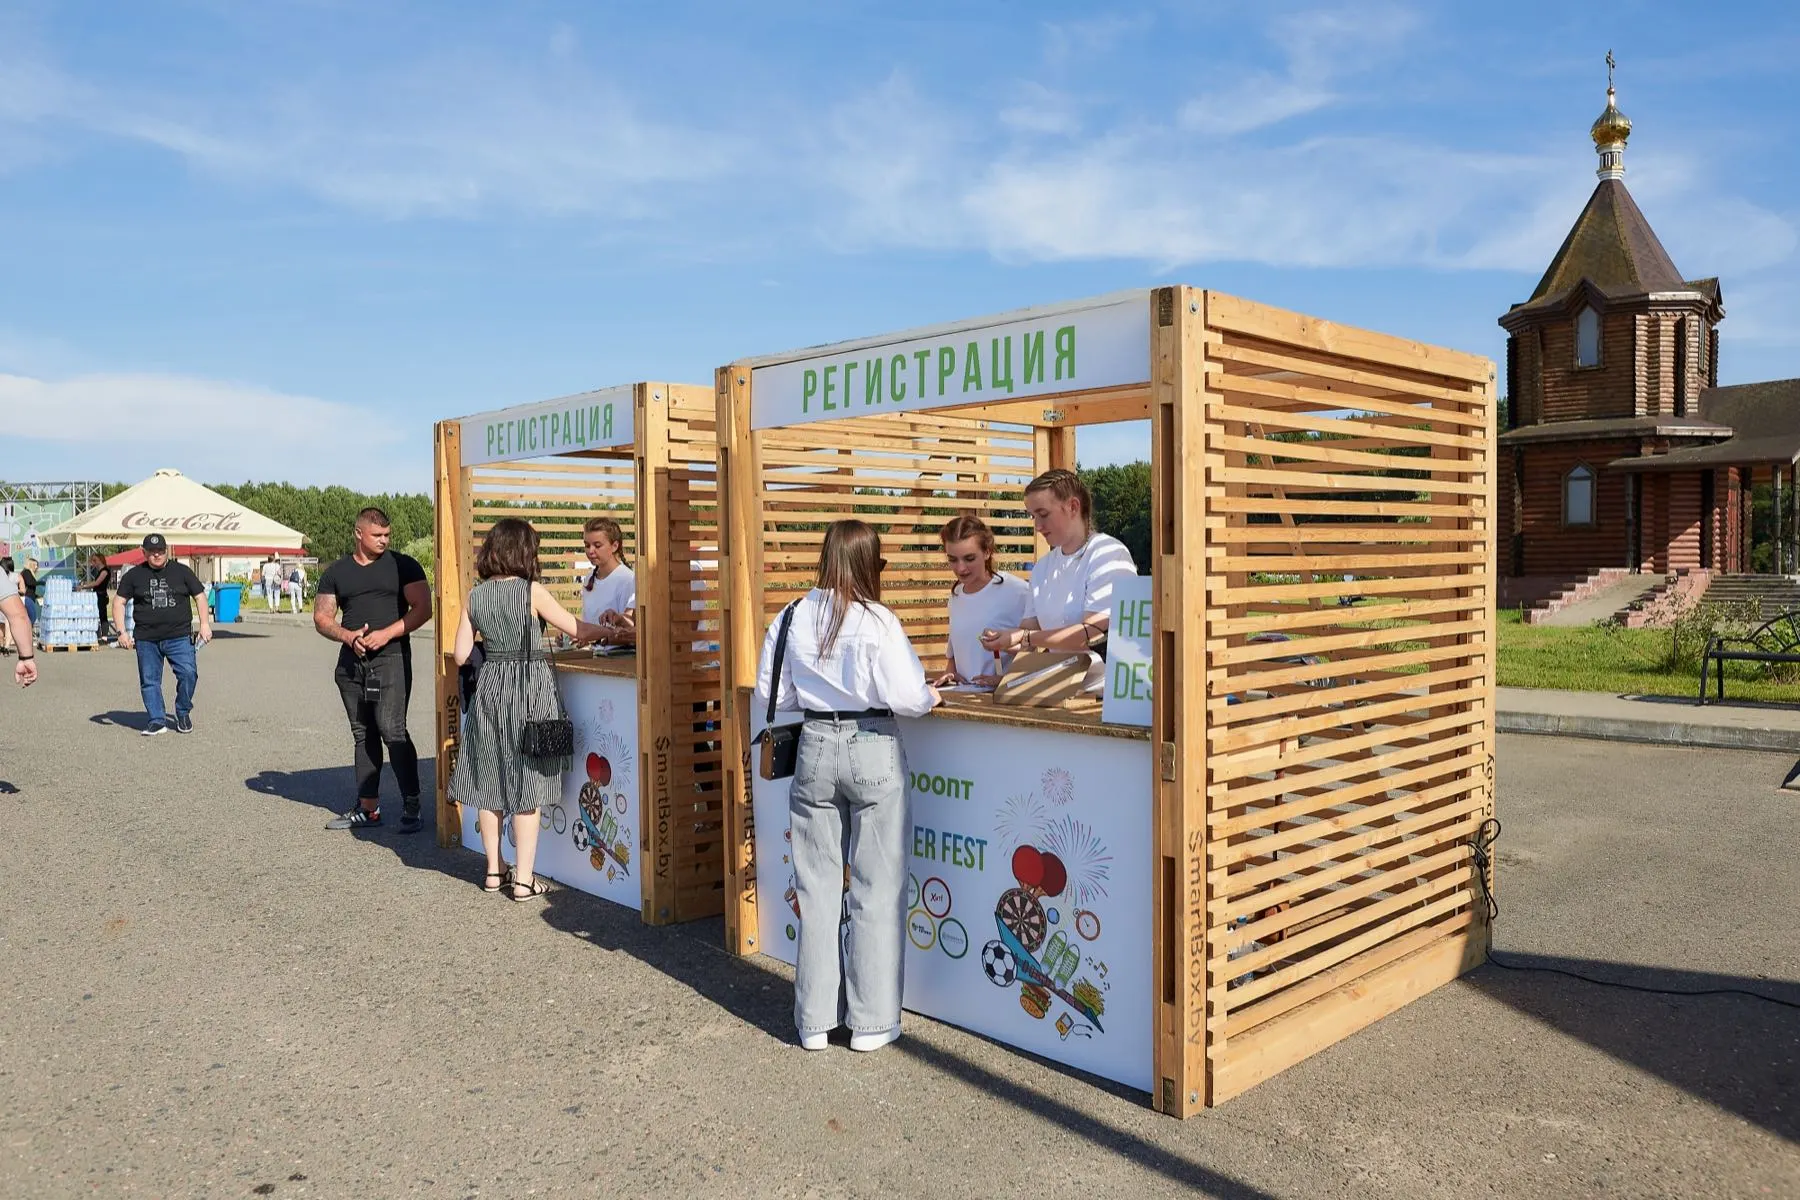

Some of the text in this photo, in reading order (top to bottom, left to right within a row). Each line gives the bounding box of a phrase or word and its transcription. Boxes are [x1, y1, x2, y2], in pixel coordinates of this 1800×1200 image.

[803, 325, 1076, 413] РЕГИСТРАЦИЯ
[487, 402, 614, 456] РЕГИСТРАЦИЯ
[1118, 600, 1153, 638] HE
[655, 736, 672, 880] SmartBox.by
[911, 825, 988, 872] ER FEST
[1187, 830, 1204, 1046] SmartBox.by
